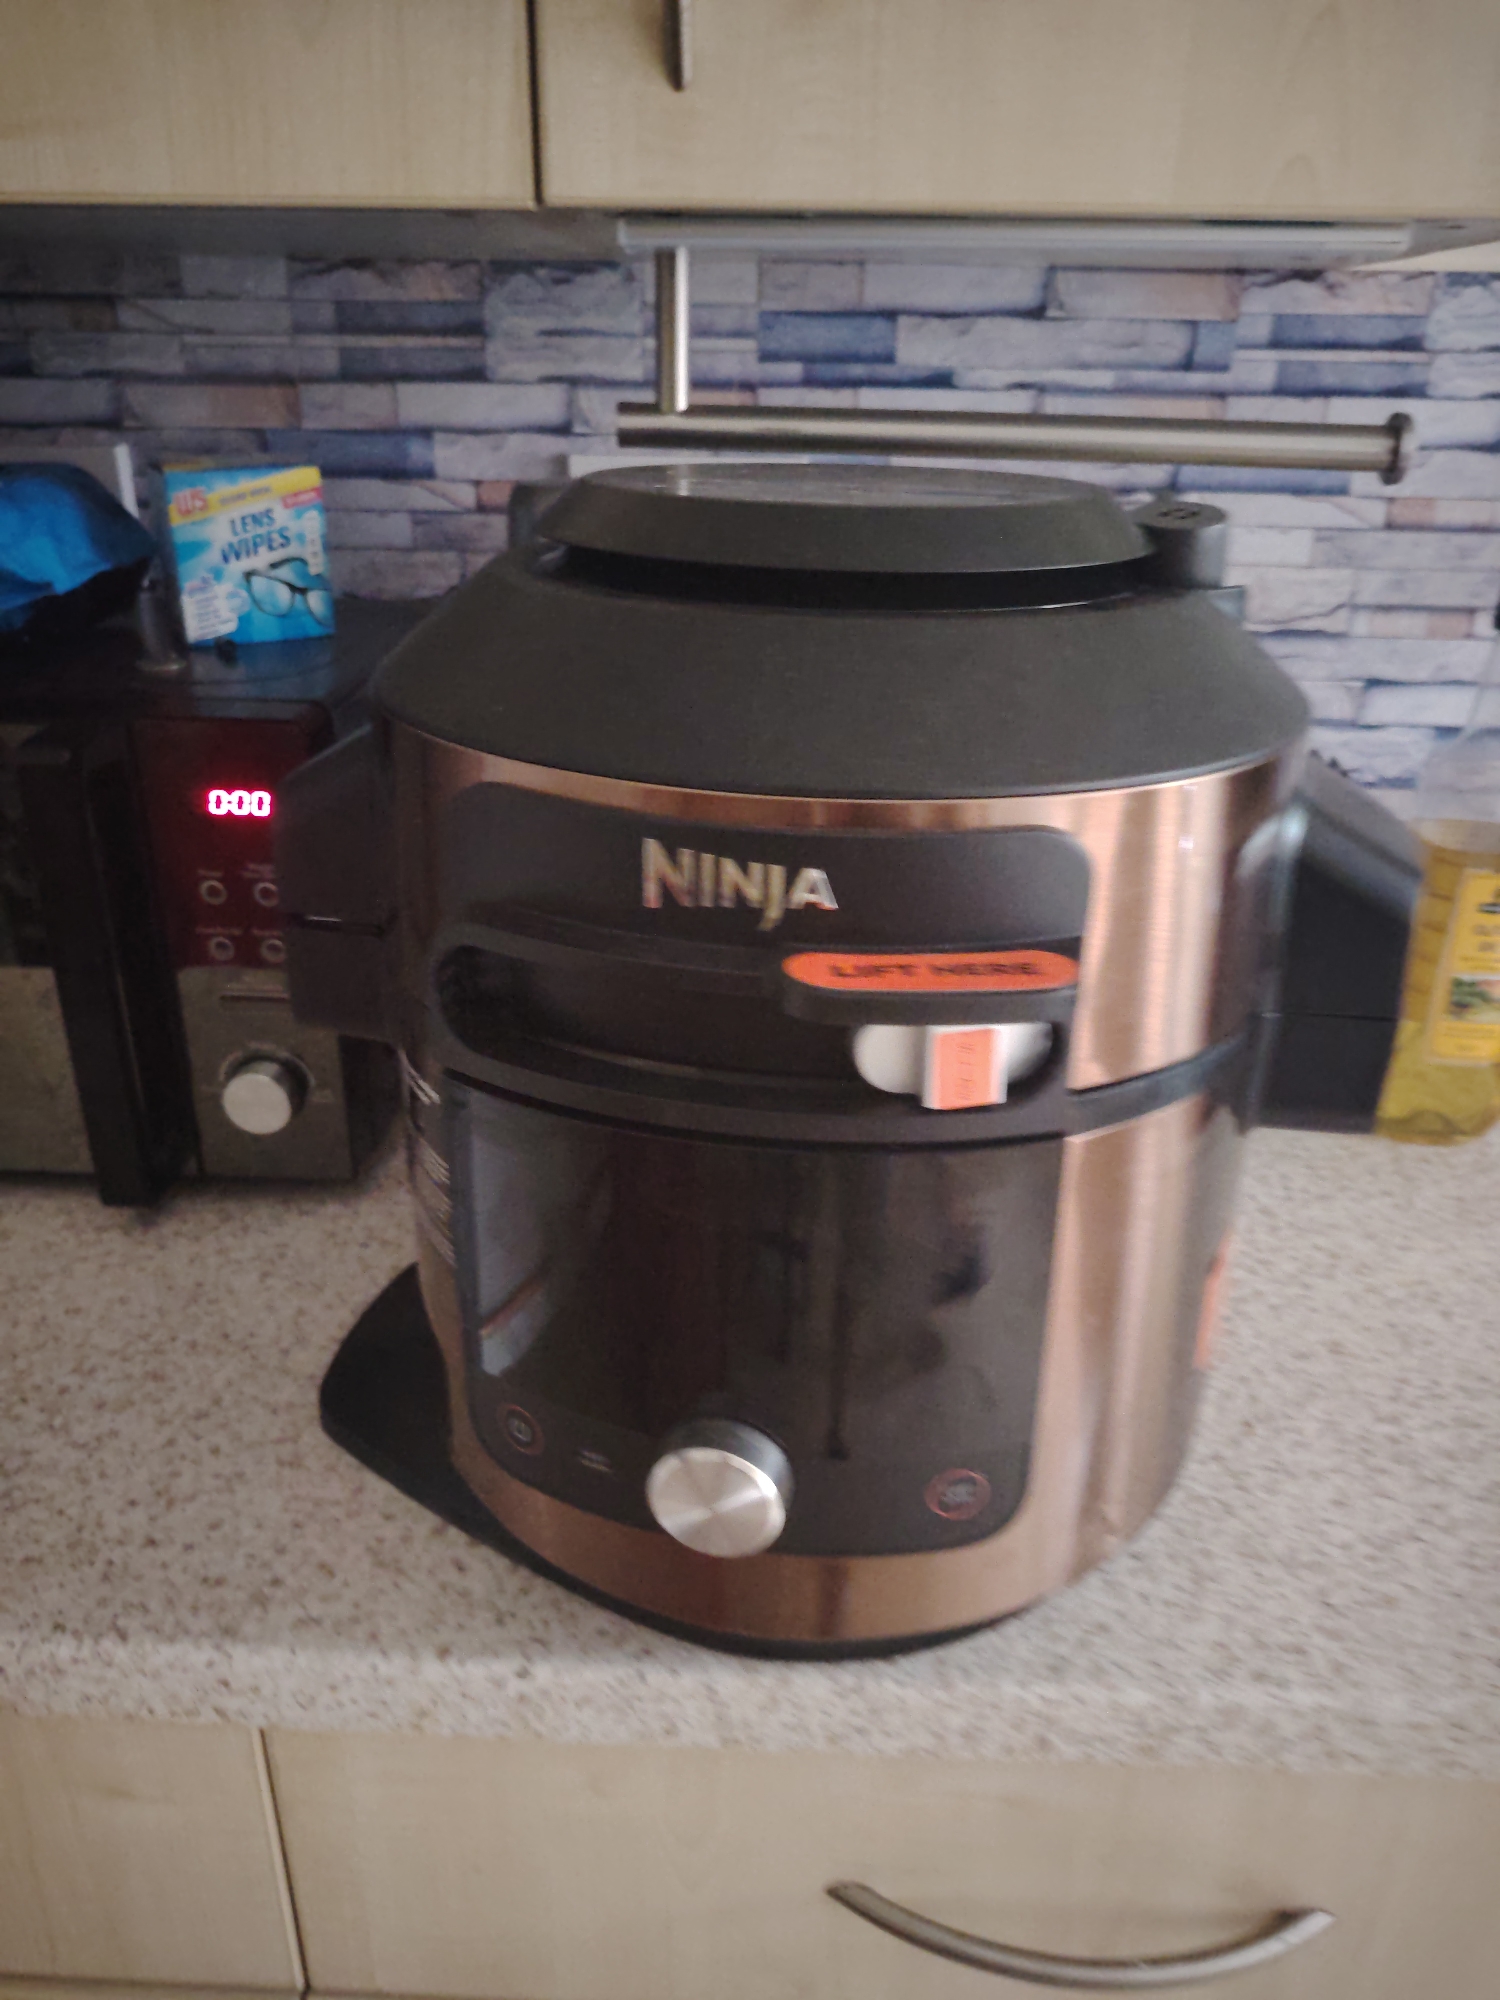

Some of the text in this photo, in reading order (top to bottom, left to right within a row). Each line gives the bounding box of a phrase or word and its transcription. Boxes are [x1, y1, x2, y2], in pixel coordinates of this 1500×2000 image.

[230, 508, 276, 537] LENS
[221, 526, 291, 564] WIPES
[641, 837, 839, 931] NINJA
[828, 961, 1040, 978] LIFT HERE
